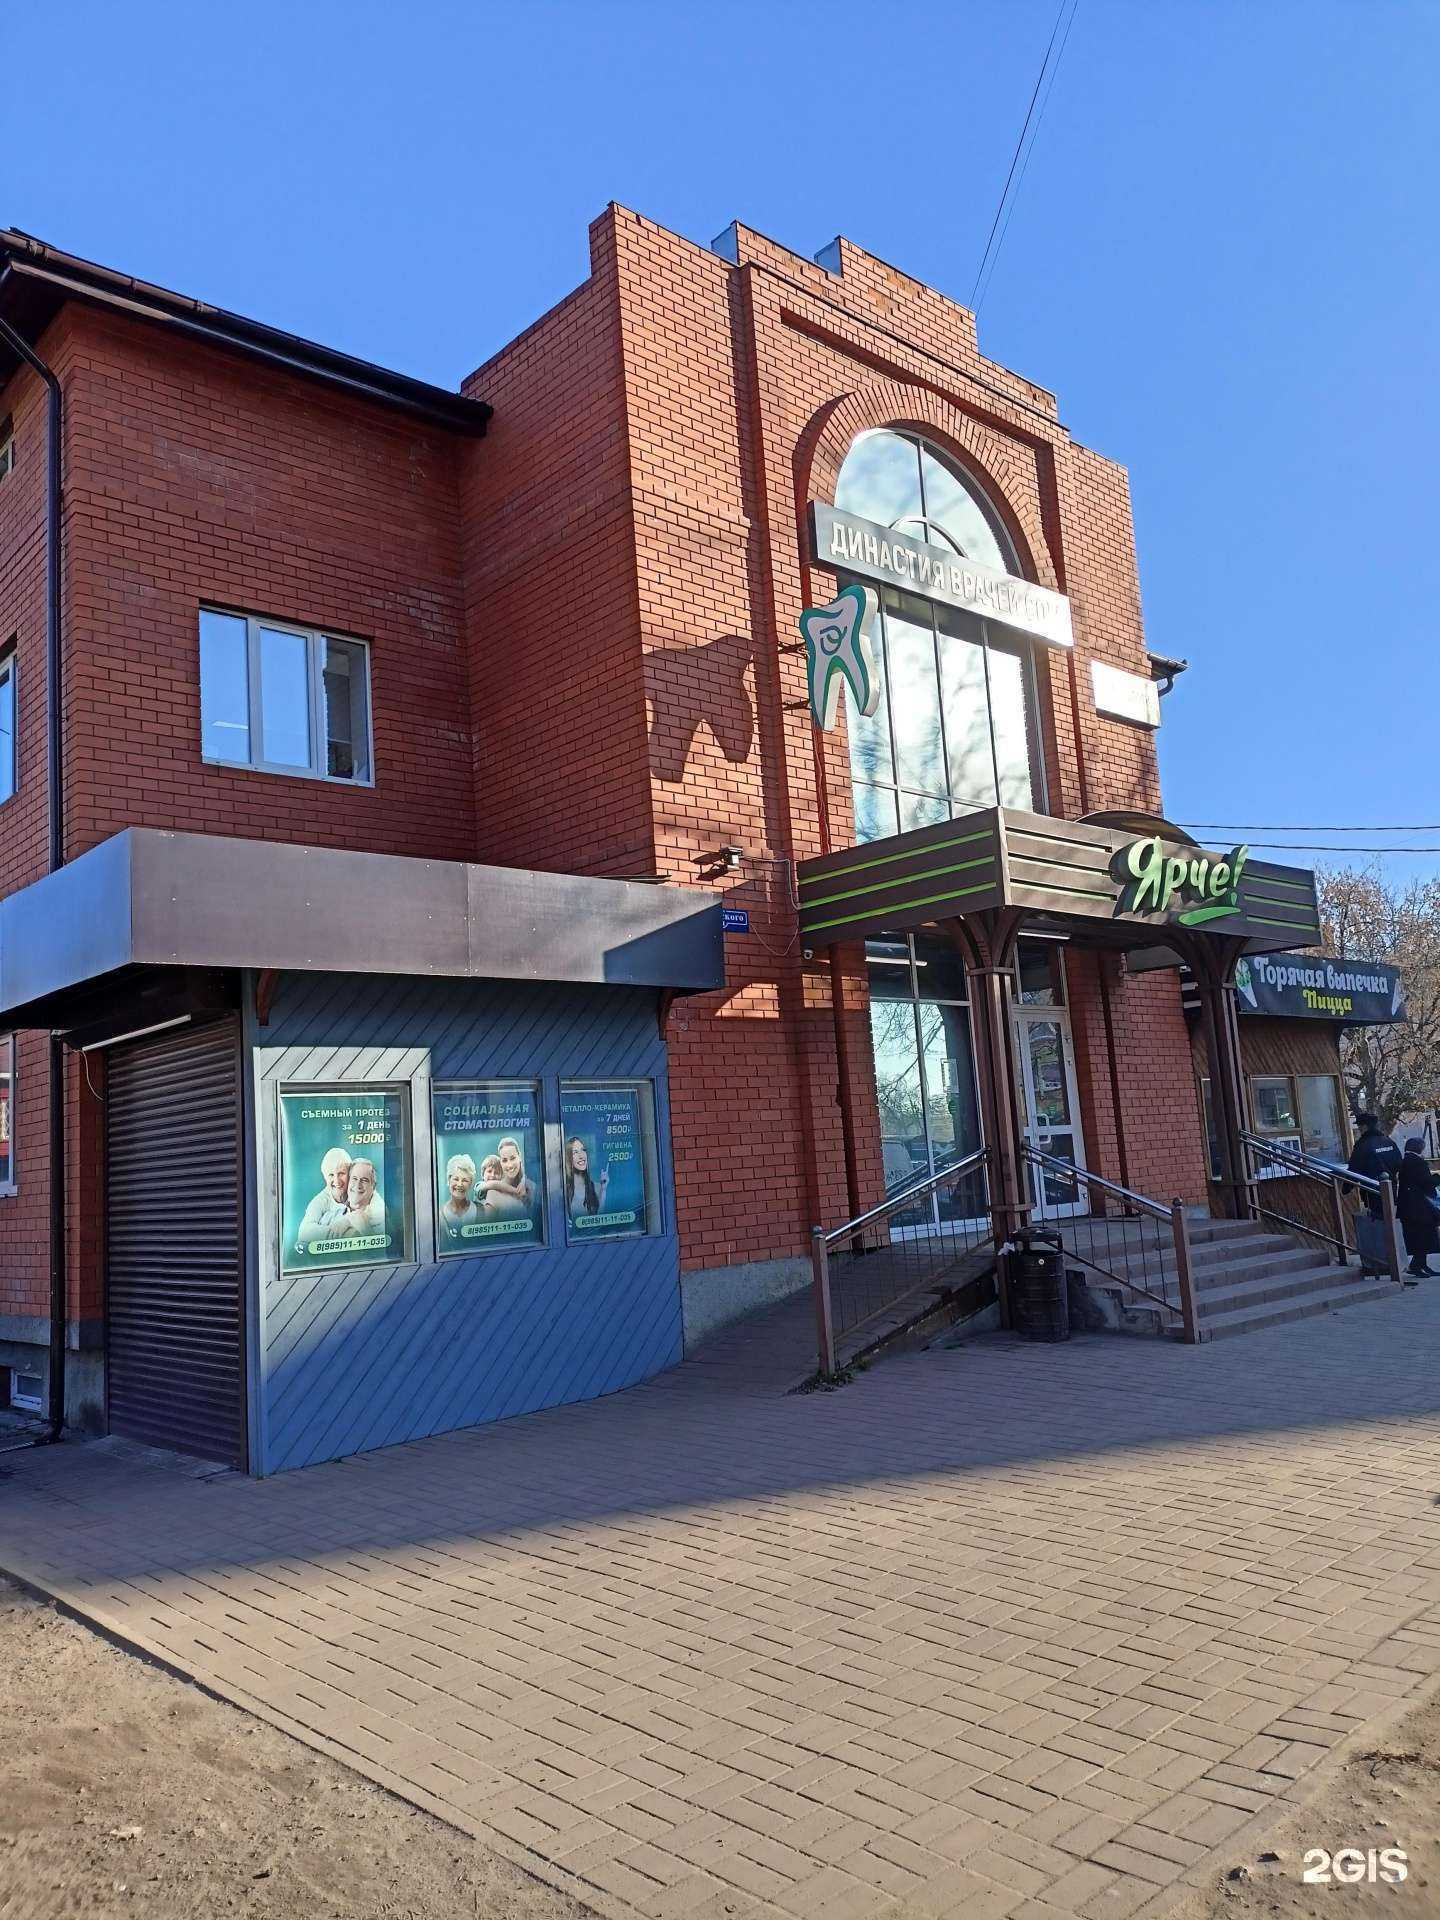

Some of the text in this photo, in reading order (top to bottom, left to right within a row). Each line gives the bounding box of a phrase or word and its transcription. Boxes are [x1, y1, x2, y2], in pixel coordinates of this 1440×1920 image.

[831, 521, 945, 591] ДИНАСТИЯ
[1127, 836, 1248, 912] Ярче!
[1254, 956, 1389, 994] Горячая выпечка
[1302, 988, 1353, 1016] Пицца
[301, 1107, 390, 1118] СЪЕМНЫЙ ПРОТЕЗ
[444, 1104, 530, 1117] СОЦИАЛЬНАЯ
[606, 1113, 612, 1122] 7
[358, 1120, 365, 1130] 1
[367, 1121, 391, 1130] ДЕНЬ
[444, 1118, 531, 1131] СТОМАТОЛОГИЯ
[316, 1237, 385, 1251] 8(985)11-11-035
